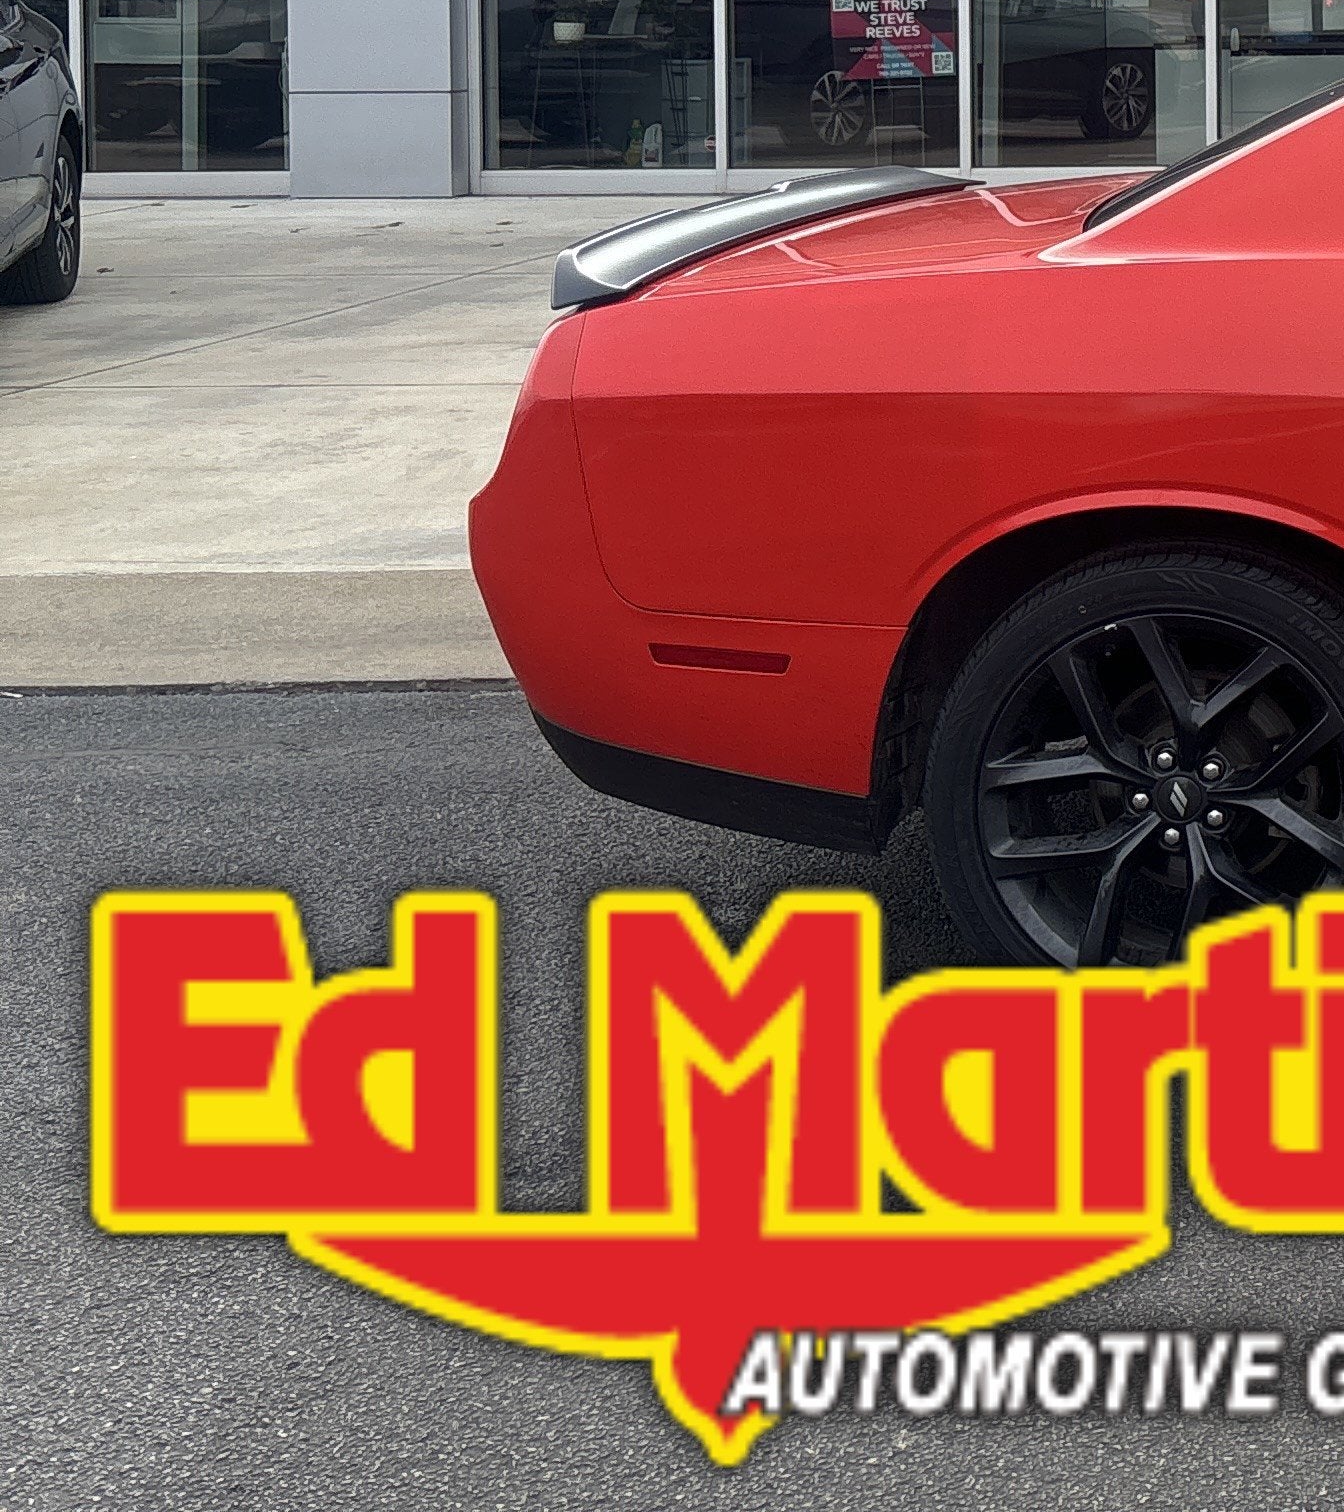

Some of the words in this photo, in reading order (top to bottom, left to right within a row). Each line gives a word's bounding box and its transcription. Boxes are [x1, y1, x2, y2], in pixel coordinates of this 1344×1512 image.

[855, 0, 879, 12] WE
[869, 12, 915, 25] STEVE
[865, 26, 920, 38] REEVES
